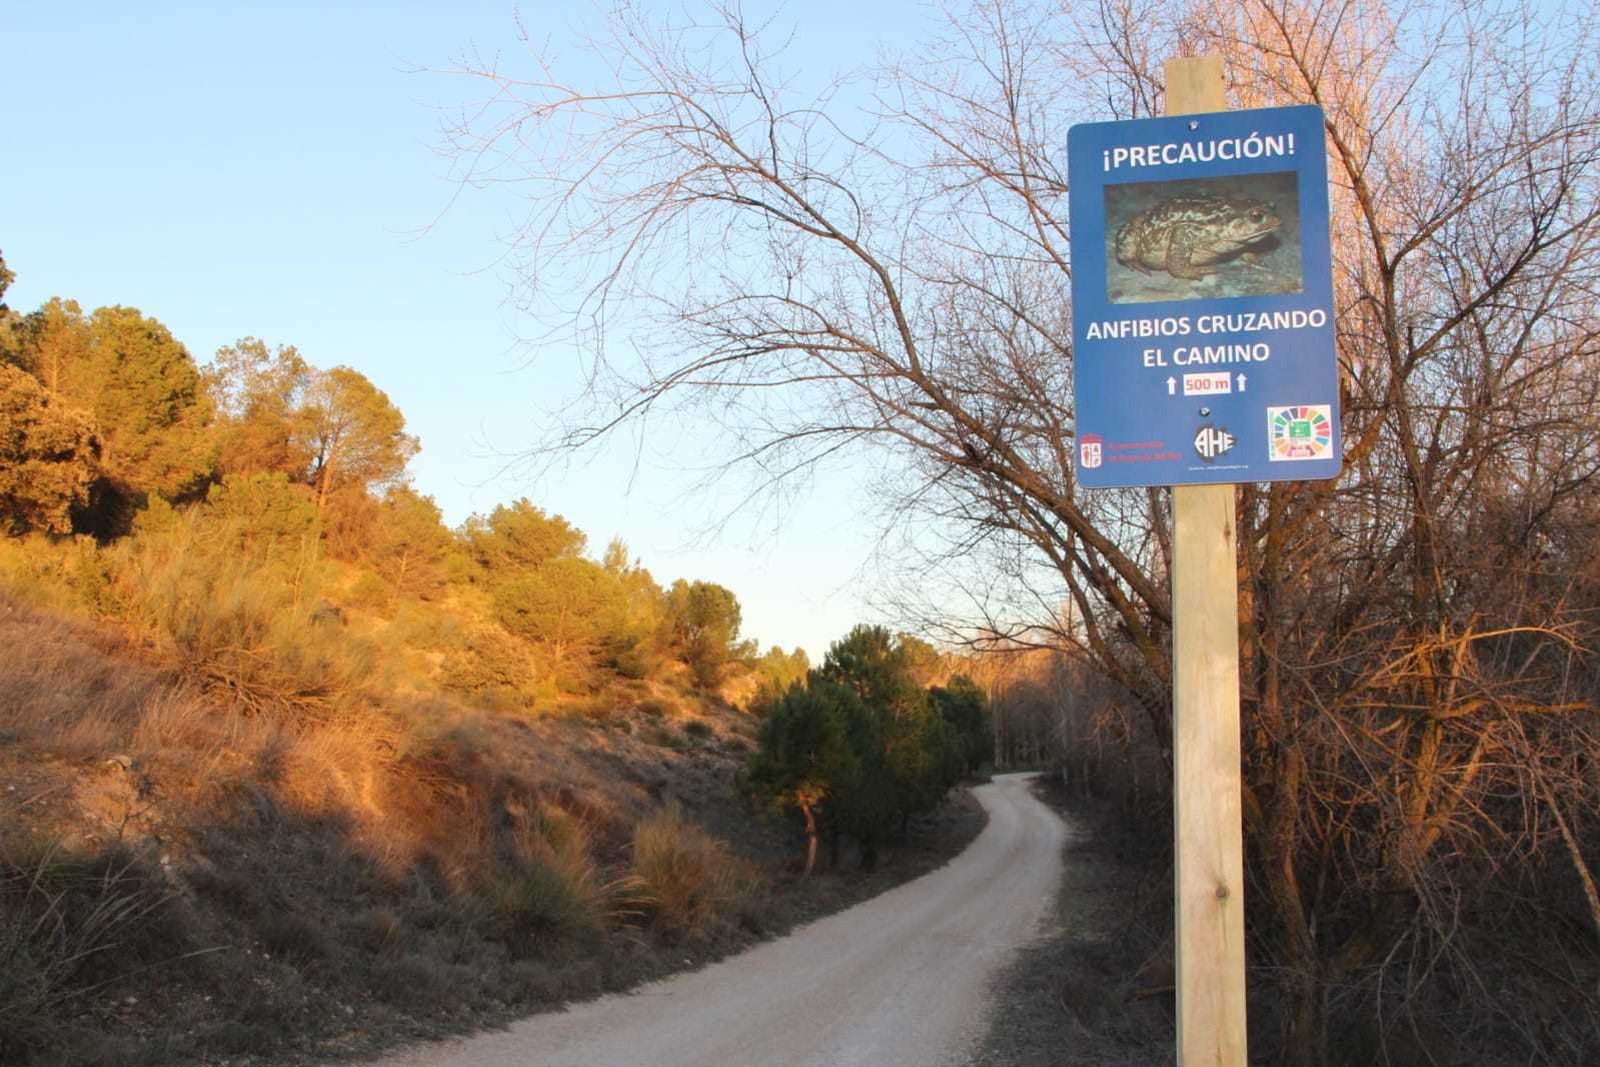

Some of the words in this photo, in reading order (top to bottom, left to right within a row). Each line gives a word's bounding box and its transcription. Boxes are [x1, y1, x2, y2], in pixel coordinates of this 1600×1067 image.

[1103, 131, 1295, 171] ¡PRECAUCIÓN!
[1086, 316, 1191, 340] ANFIBIOS
[1197, 309, 1326, 334] CRUZANDO
[1143, 349, 1167, 368] EL
[1173, 343, 1270, 365] CAMINO
[1185, 378, 1211, 391] 500
[1215, 379, 1229, 389] m
[1194, 427, 1235, 458] AHE
